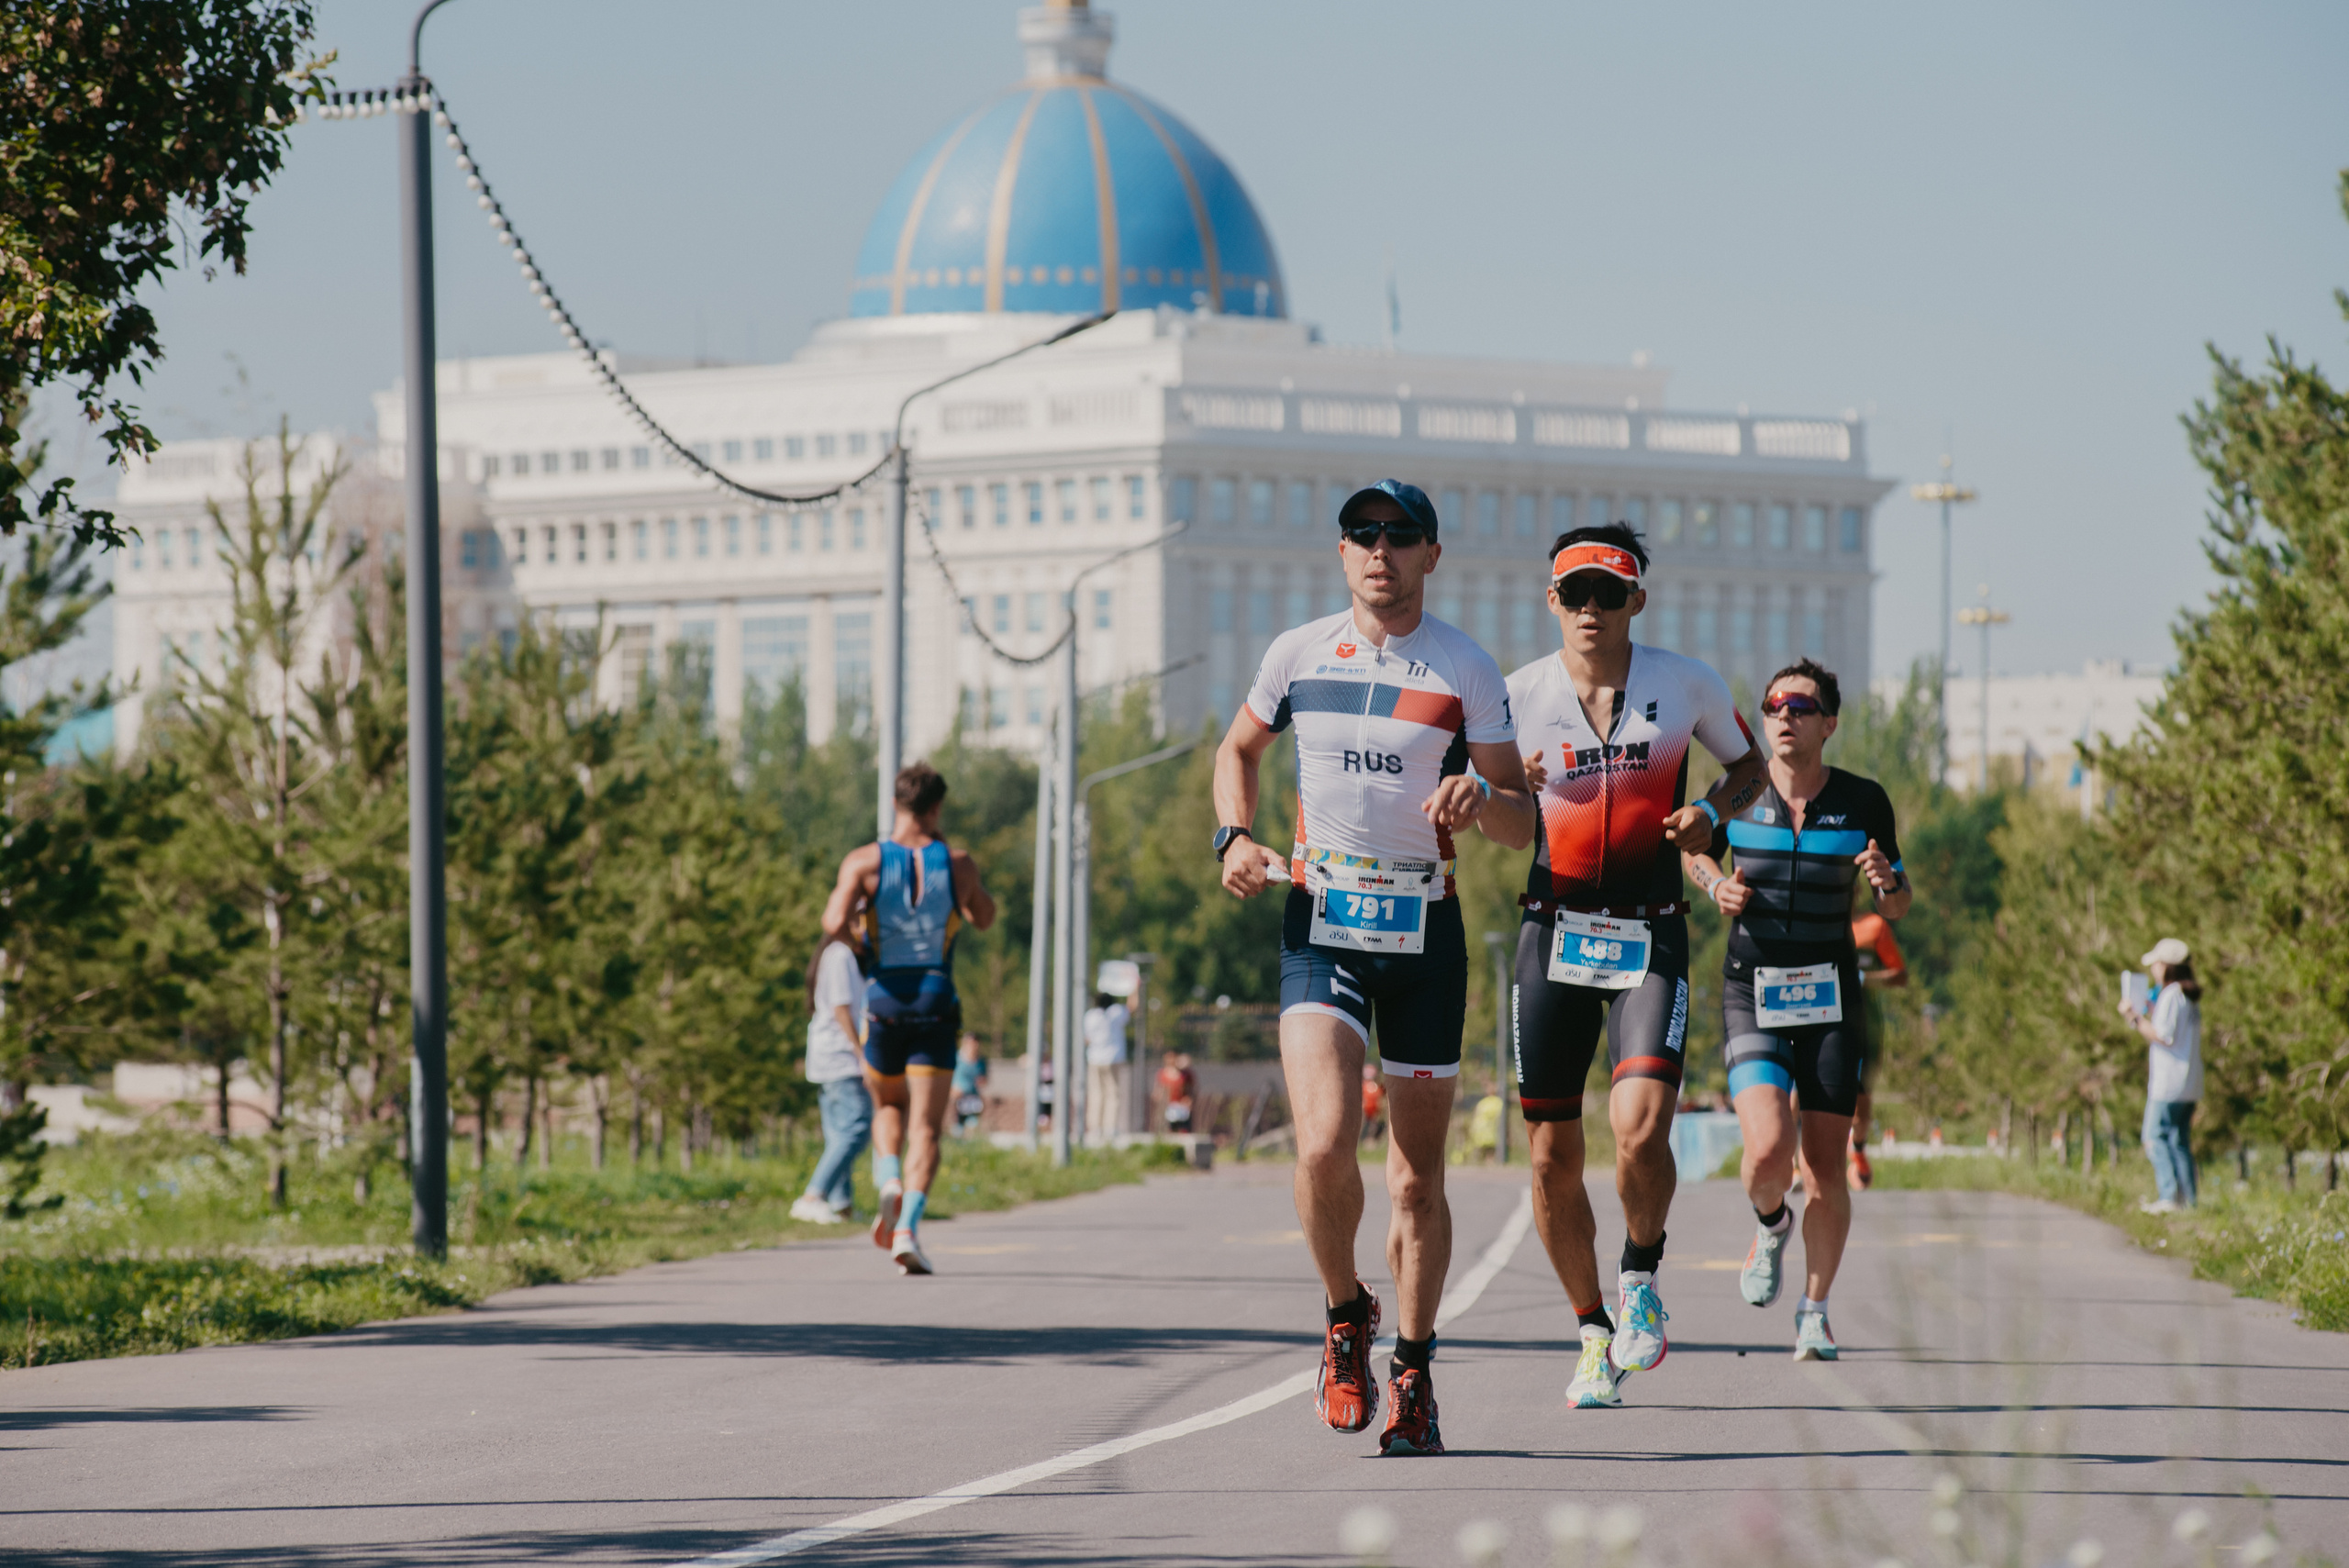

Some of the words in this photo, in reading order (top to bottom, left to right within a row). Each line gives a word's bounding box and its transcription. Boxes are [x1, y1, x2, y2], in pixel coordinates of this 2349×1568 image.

[1407, 661, 1430, 678] Tri
[1343, 750, 1403, 774] RUS
[1566, 762, 1648, 780] QAZAQSTAN
[1358, 874, 1395, 885] IRONMAN
[1358, 882, 1373, 890] 70.3
[1346, 894, 1395, 921] 791
[1360, 920, 1377, 929] Kirill
[1590, 921, 1621, 931] IRONMAN
[1579, 937, 1622, 962] 488
[1580, 958, 1618, 970] Yerkebulan
[1779, 984, 1817, 1002] 496
